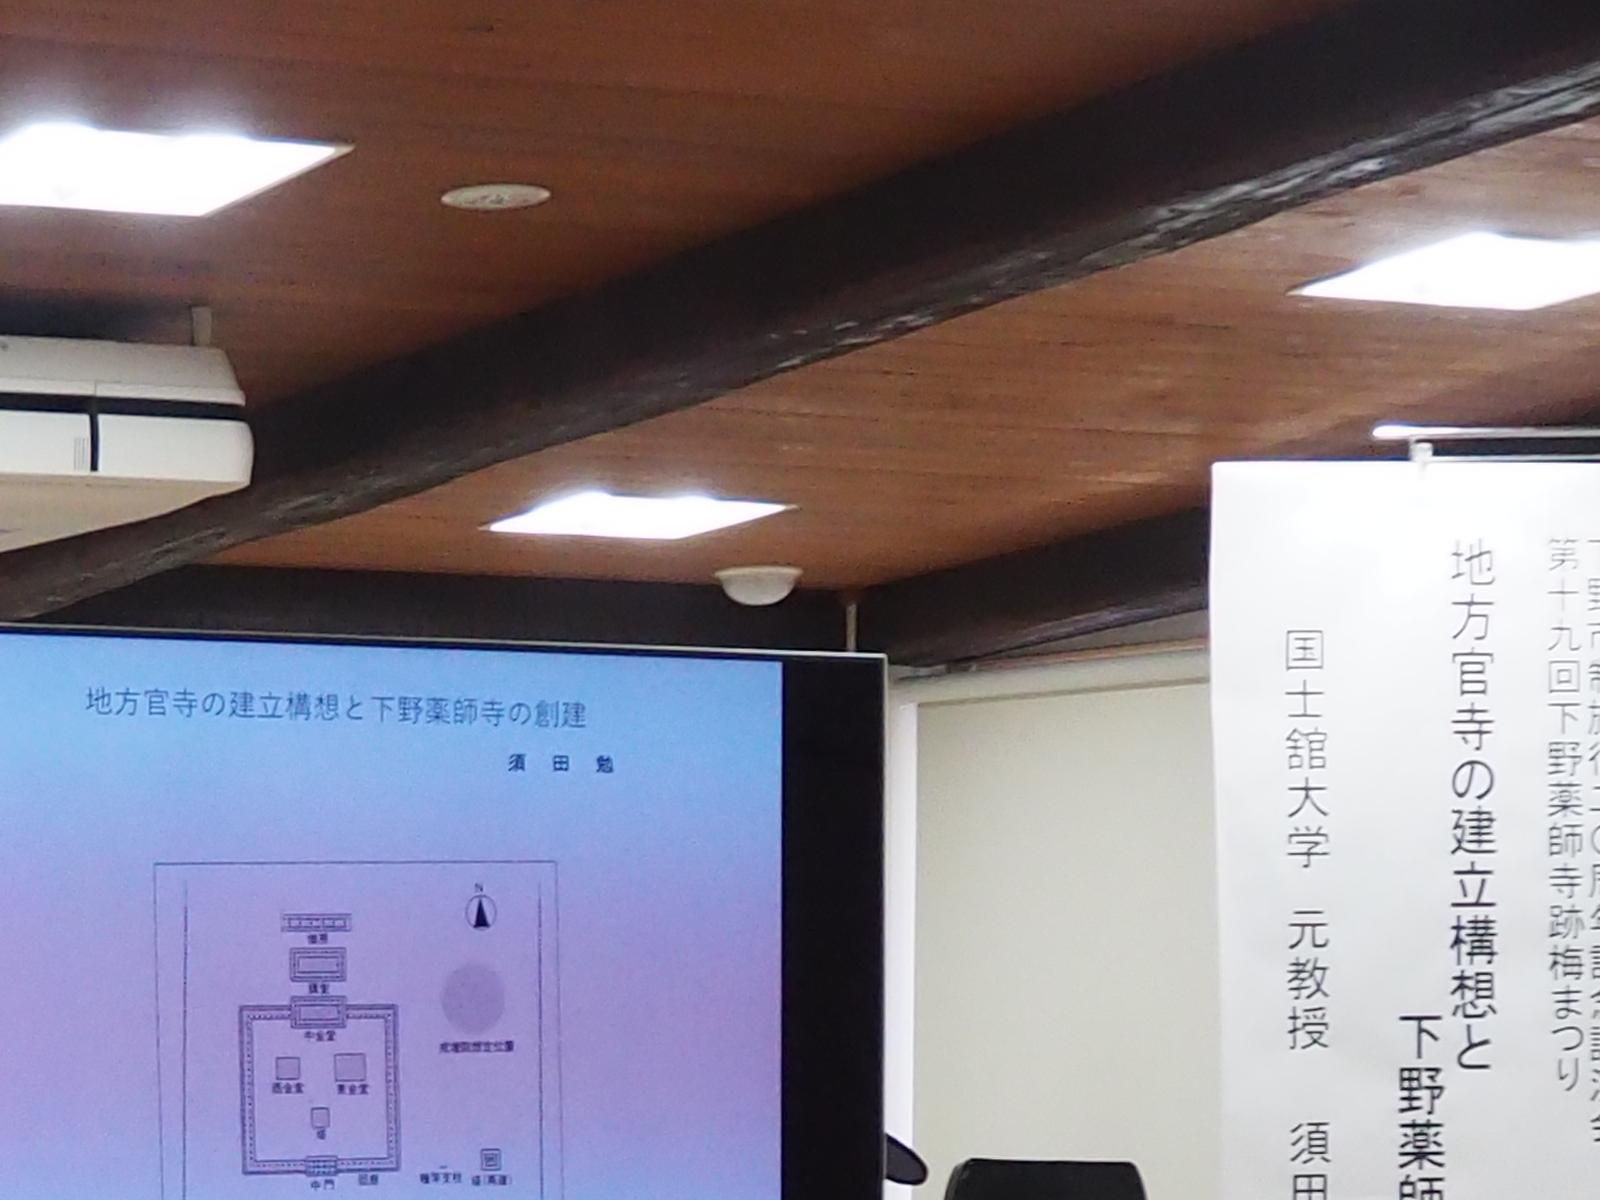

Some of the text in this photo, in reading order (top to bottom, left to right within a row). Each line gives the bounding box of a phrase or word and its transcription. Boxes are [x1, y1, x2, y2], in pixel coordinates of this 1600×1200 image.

[85, 686, 588, 729] 地方官寺の建立構想と下野薬師寺の創建
[1448, 538, 1500, 1072] 地方官寺の建立構想と
[1546, 537, 1584, 1093] 第十九回下野薬師寺跡梅まつり
[1286, 909, 1331, 1051] 元教授
